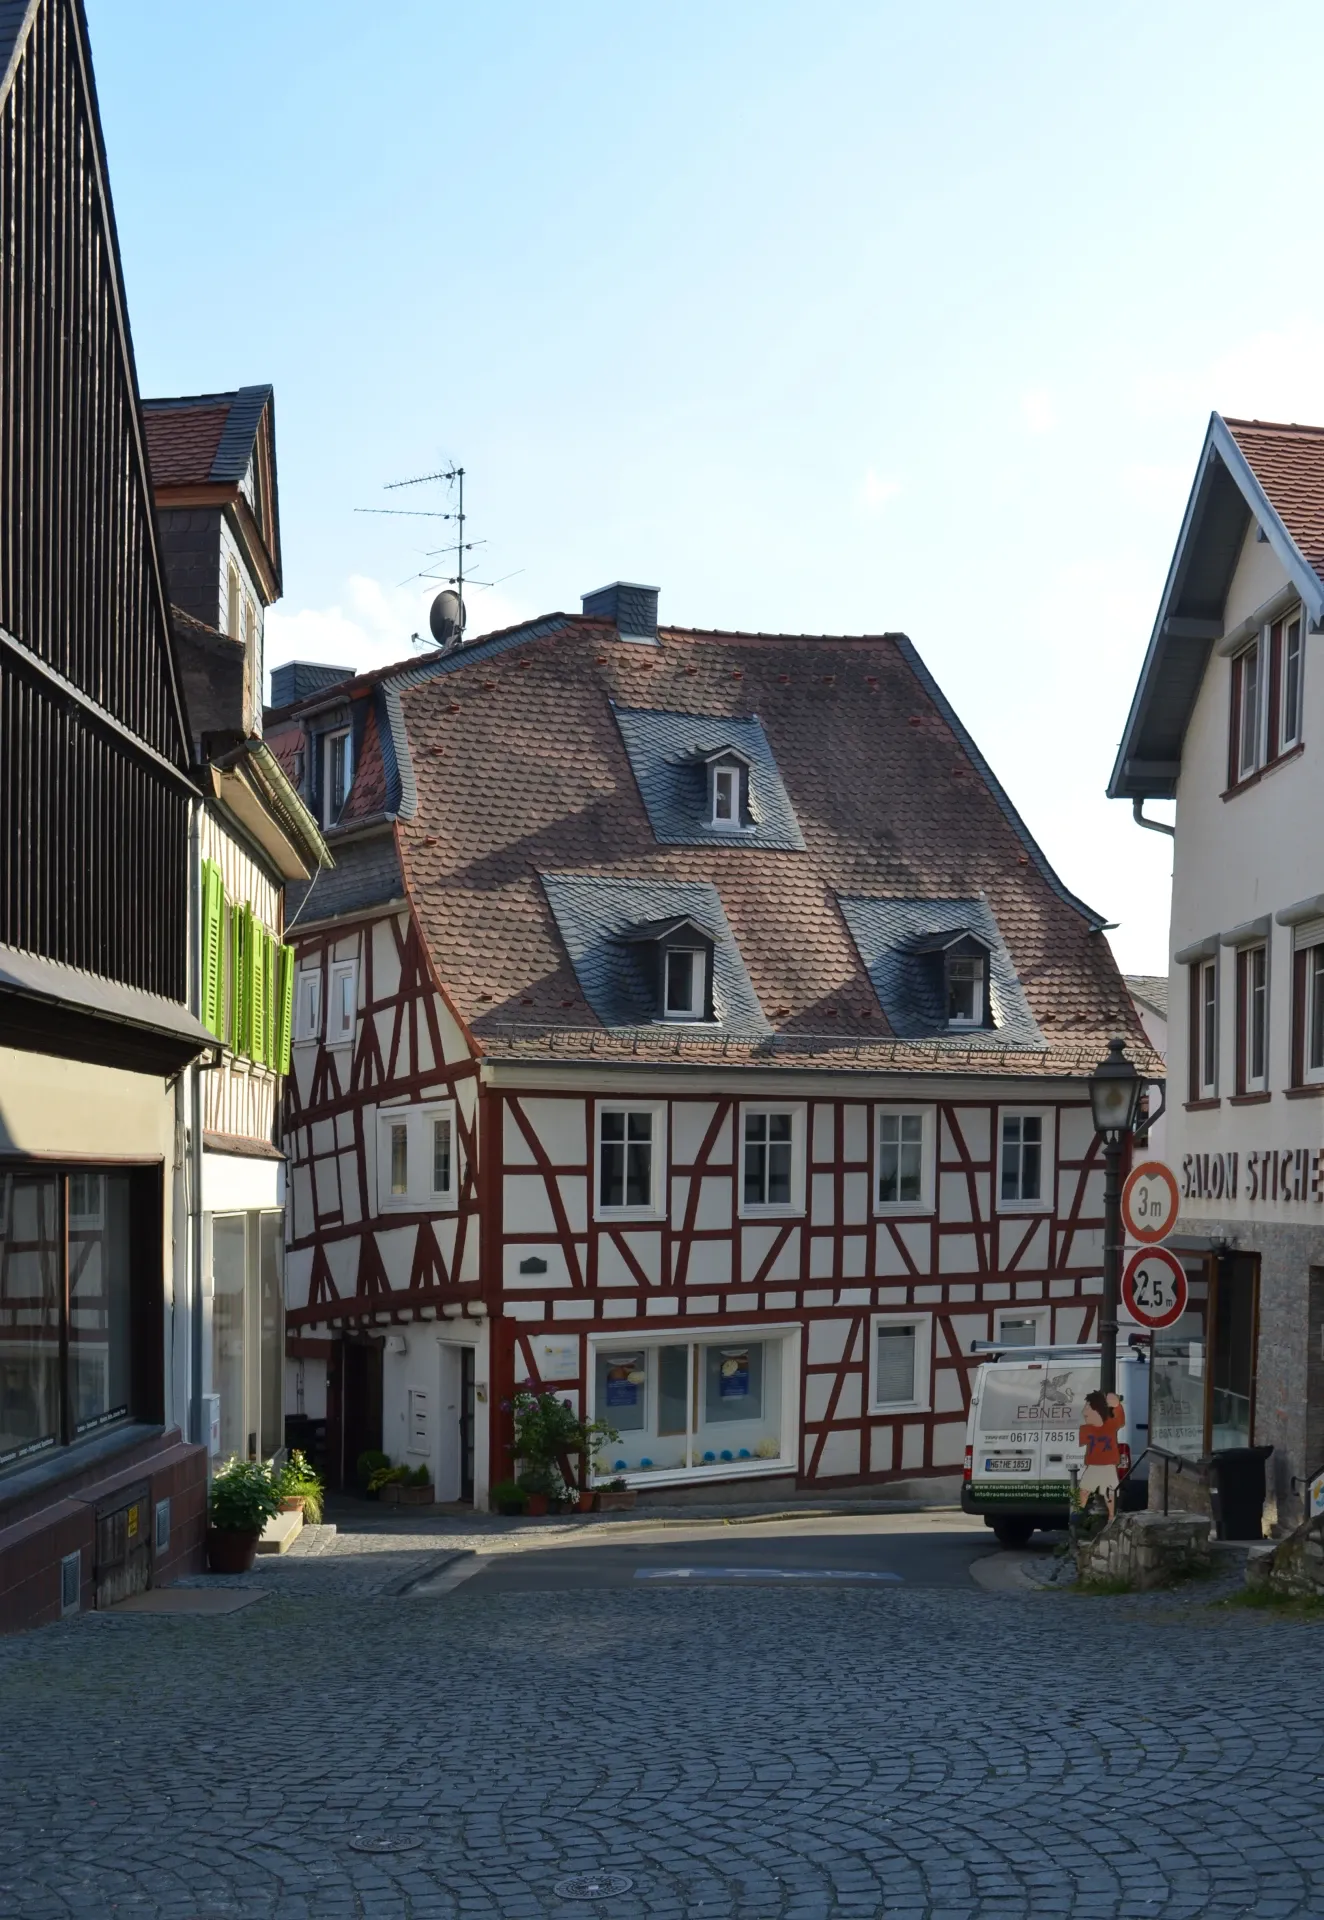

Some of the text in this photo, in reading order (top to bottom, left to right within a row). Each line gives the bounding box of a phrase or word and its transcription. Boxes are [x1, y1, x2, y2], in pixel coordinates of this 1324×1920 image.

[1182, 1152, 1239, 1199] SALON
[1138, 1186, 1162, 1217] 3 m
[1136, 1270, 1173, 1308] 2,5 m
[1017, 1405, 1072, 1419] EBNER
[1010, 1431, 1075, 1443] 06173 78515
[1012, 1460, 1029, 1468] 1851
